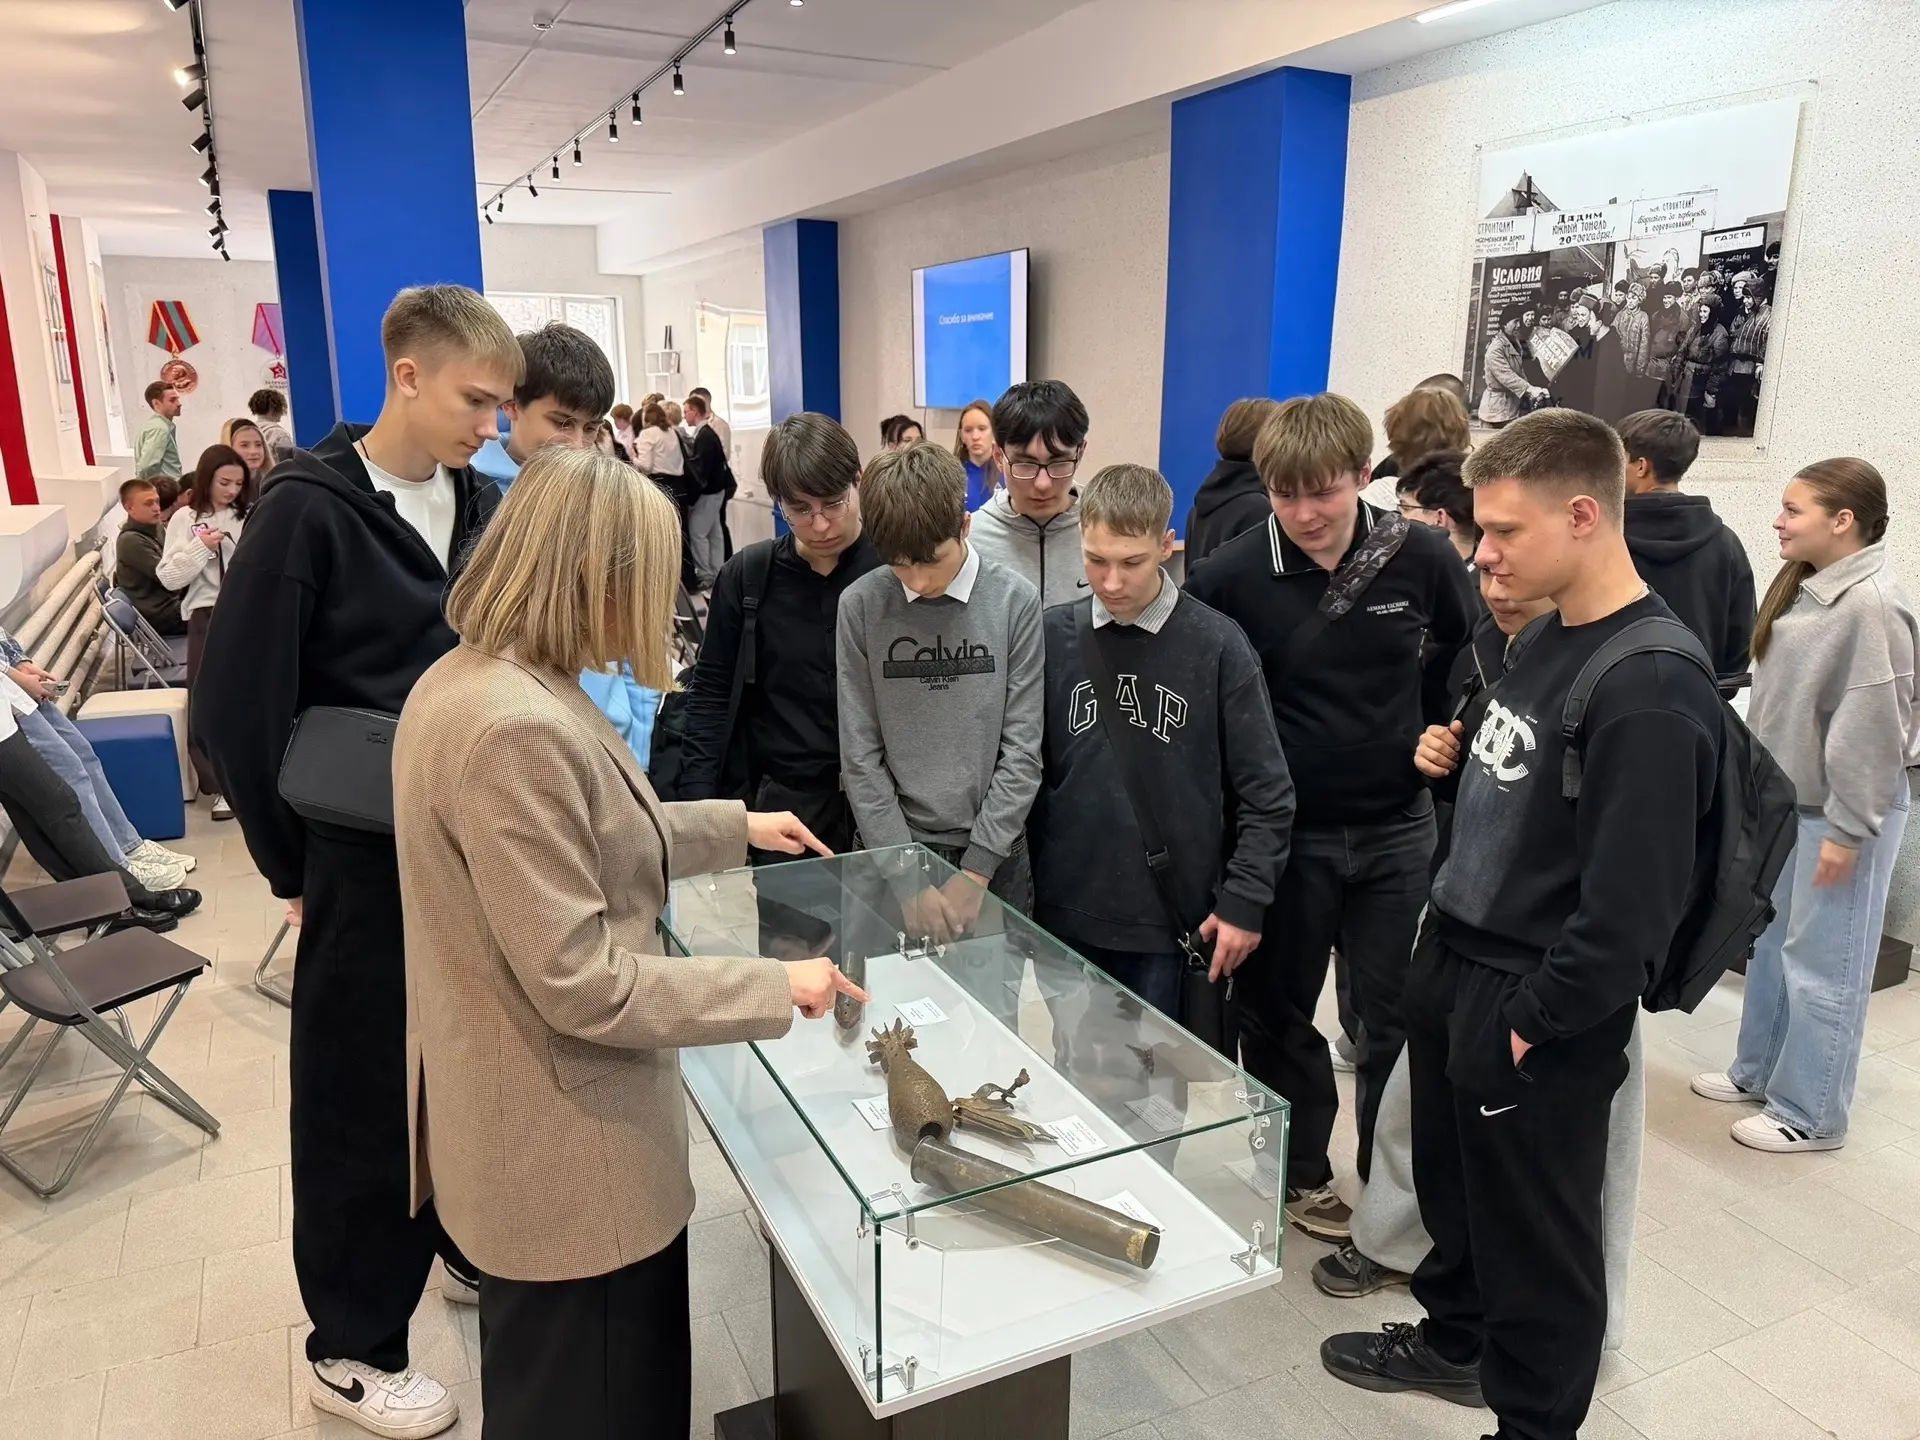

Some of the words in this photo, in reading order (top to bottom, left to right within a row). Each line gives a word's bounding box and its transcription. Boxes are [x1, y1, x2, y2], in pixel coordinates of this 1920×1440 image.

[1714, 232, 1751, 242] ГАЗЕТА
[1492, 266, 1542, 285] УСЛОВИЯ
[888, 635, 989, 662] Calvin
[920, 676, 940, 684] Calvin
[1068, 674, 1188, 744] GAP
